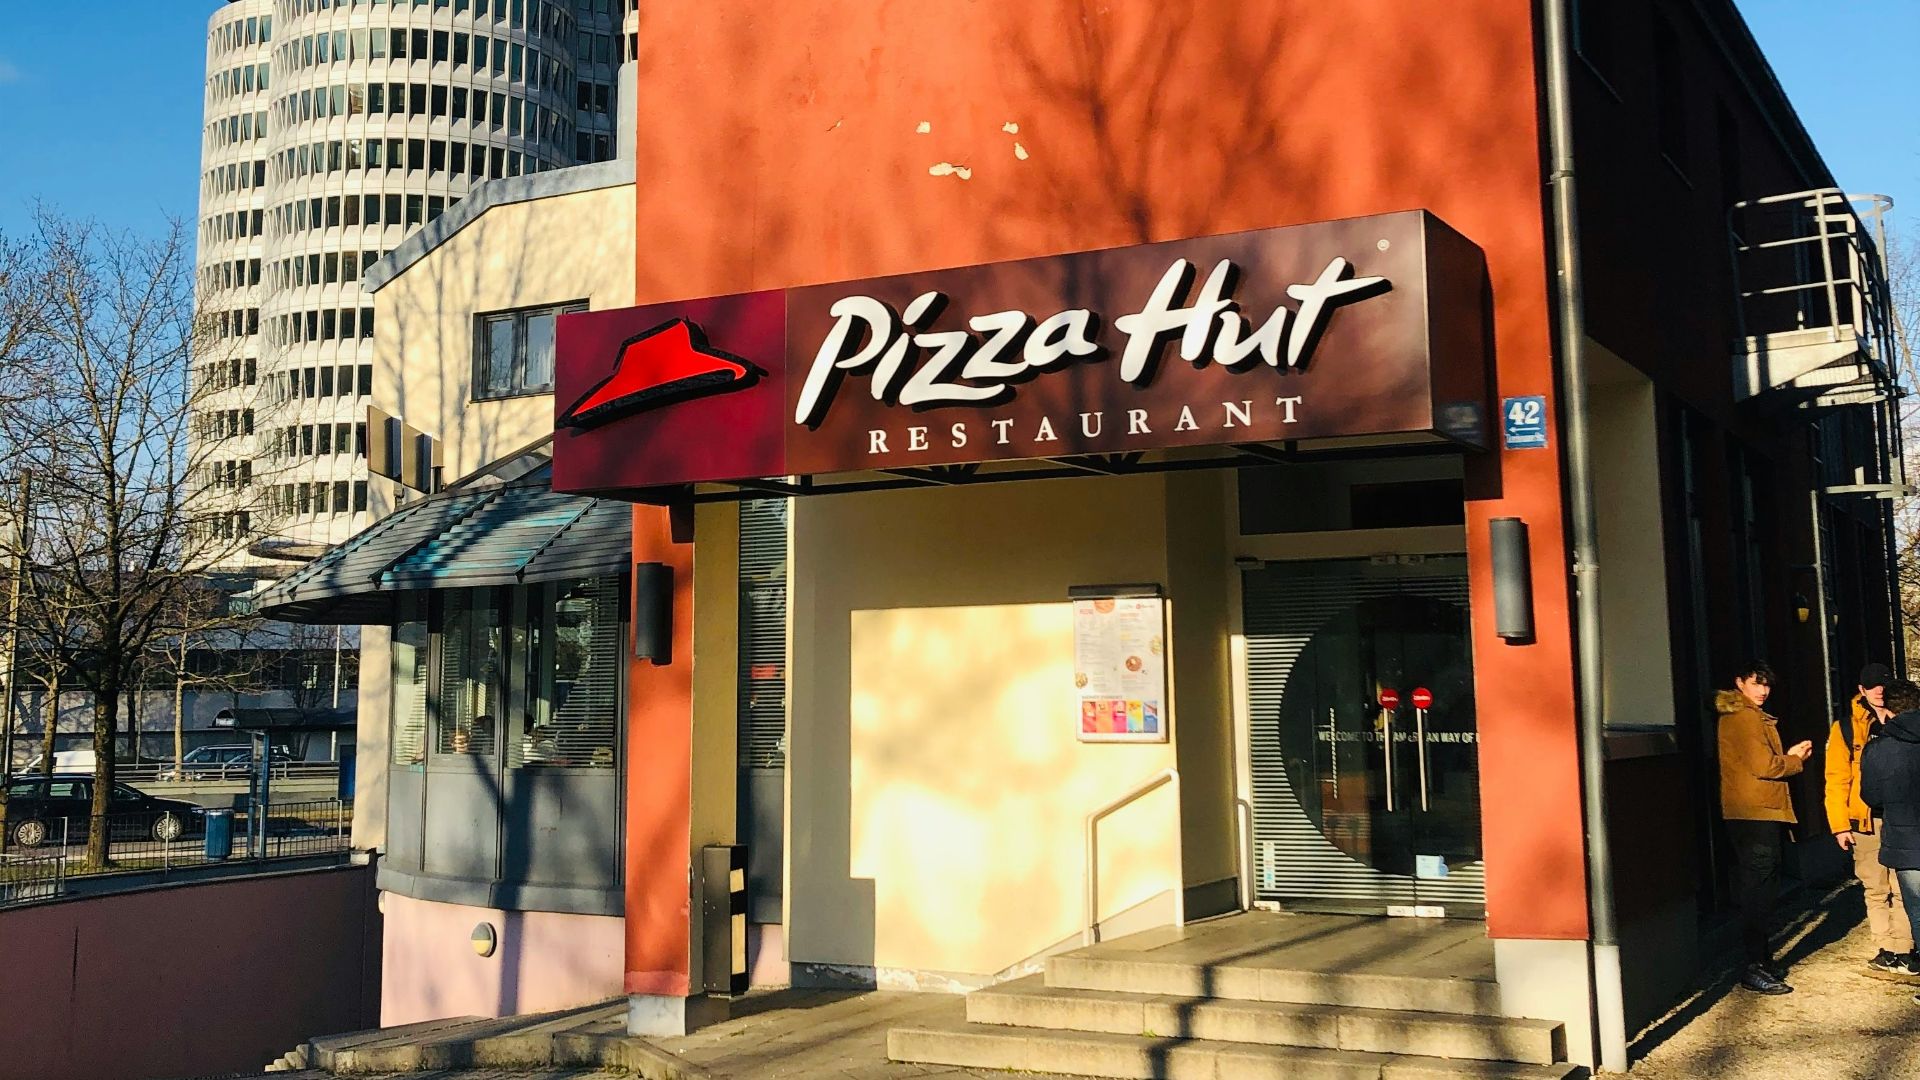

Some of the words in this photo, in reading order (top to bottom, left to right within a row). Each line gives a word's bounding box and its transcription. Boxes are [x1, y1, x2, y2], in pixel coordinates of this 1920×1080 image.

[795, 291, 1099, 426] Pizza
[1114, 256, 1390, 383] Hut
[868, 395, 1303, 455] RESTAURANT
[1508, 401, 1540, 426] 42
[1361, 731, 1374, 742] TO
[1440, 732, 1461, 743] WAY
[1461, 731, 1475, 743] OF
